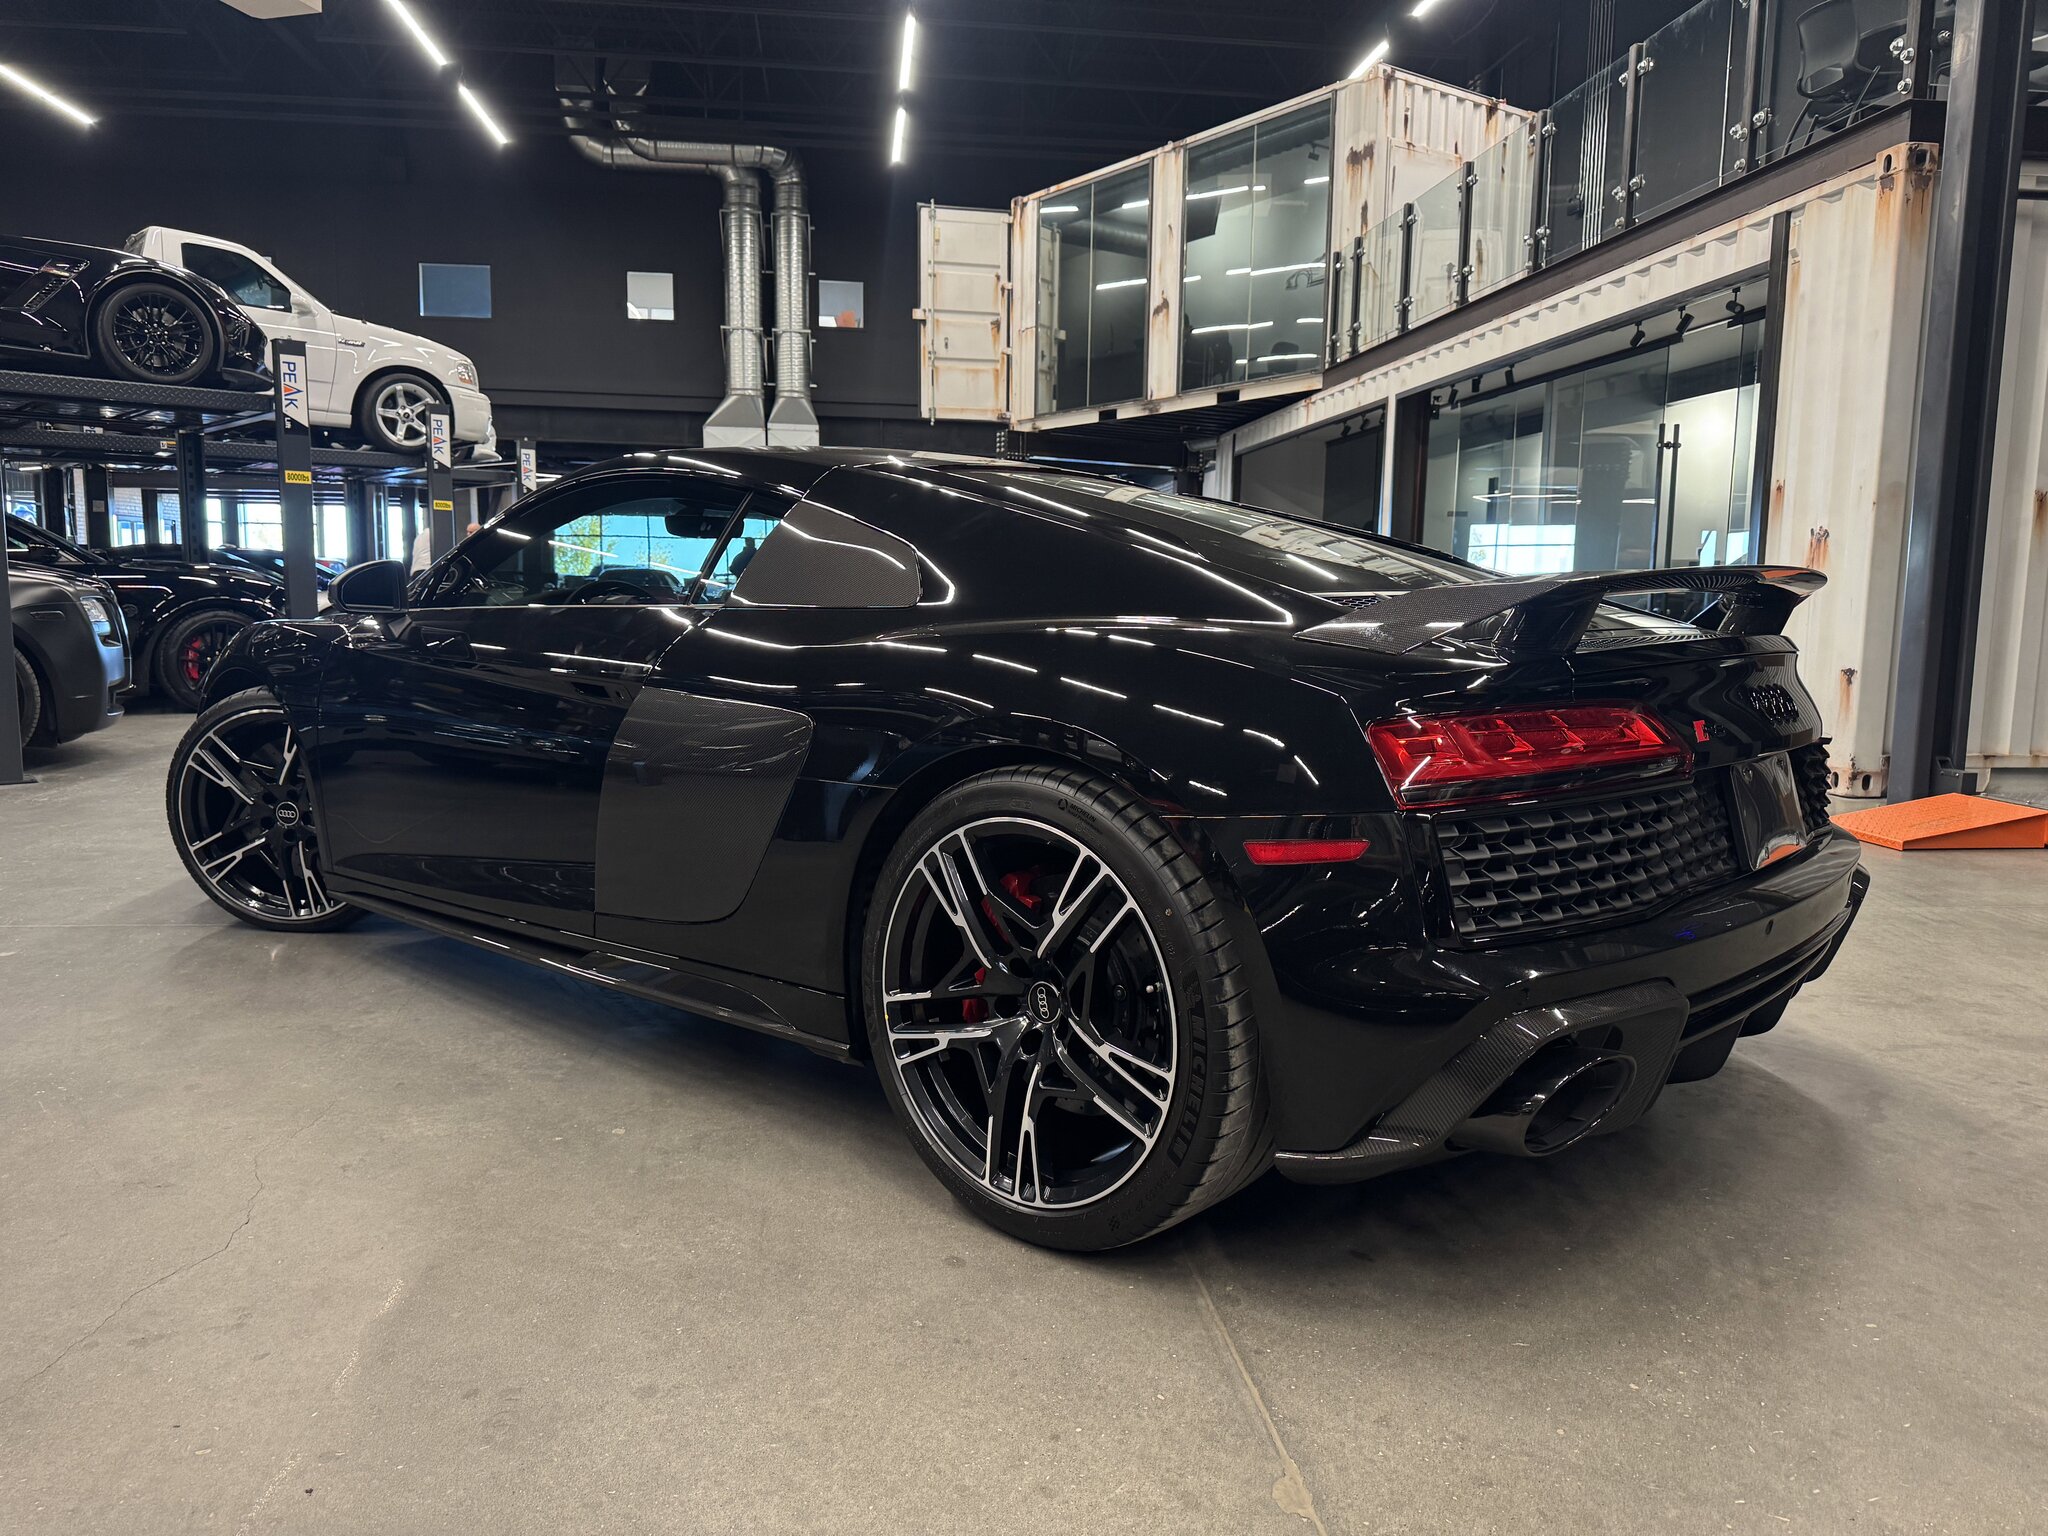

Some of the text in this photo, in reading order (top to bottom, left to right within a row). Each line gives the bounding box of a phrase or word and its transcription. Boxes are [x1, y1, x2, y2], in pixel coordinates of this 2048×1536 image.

[282, 361, 304, 409] PEAK
[433, 419, 447, 455] PEAK
[523, 453, 533, 481] PEAK
[1069, 803, 1097, 823] MICHELIN
[1170, 1014, 1208, 1162] MICHELIN
